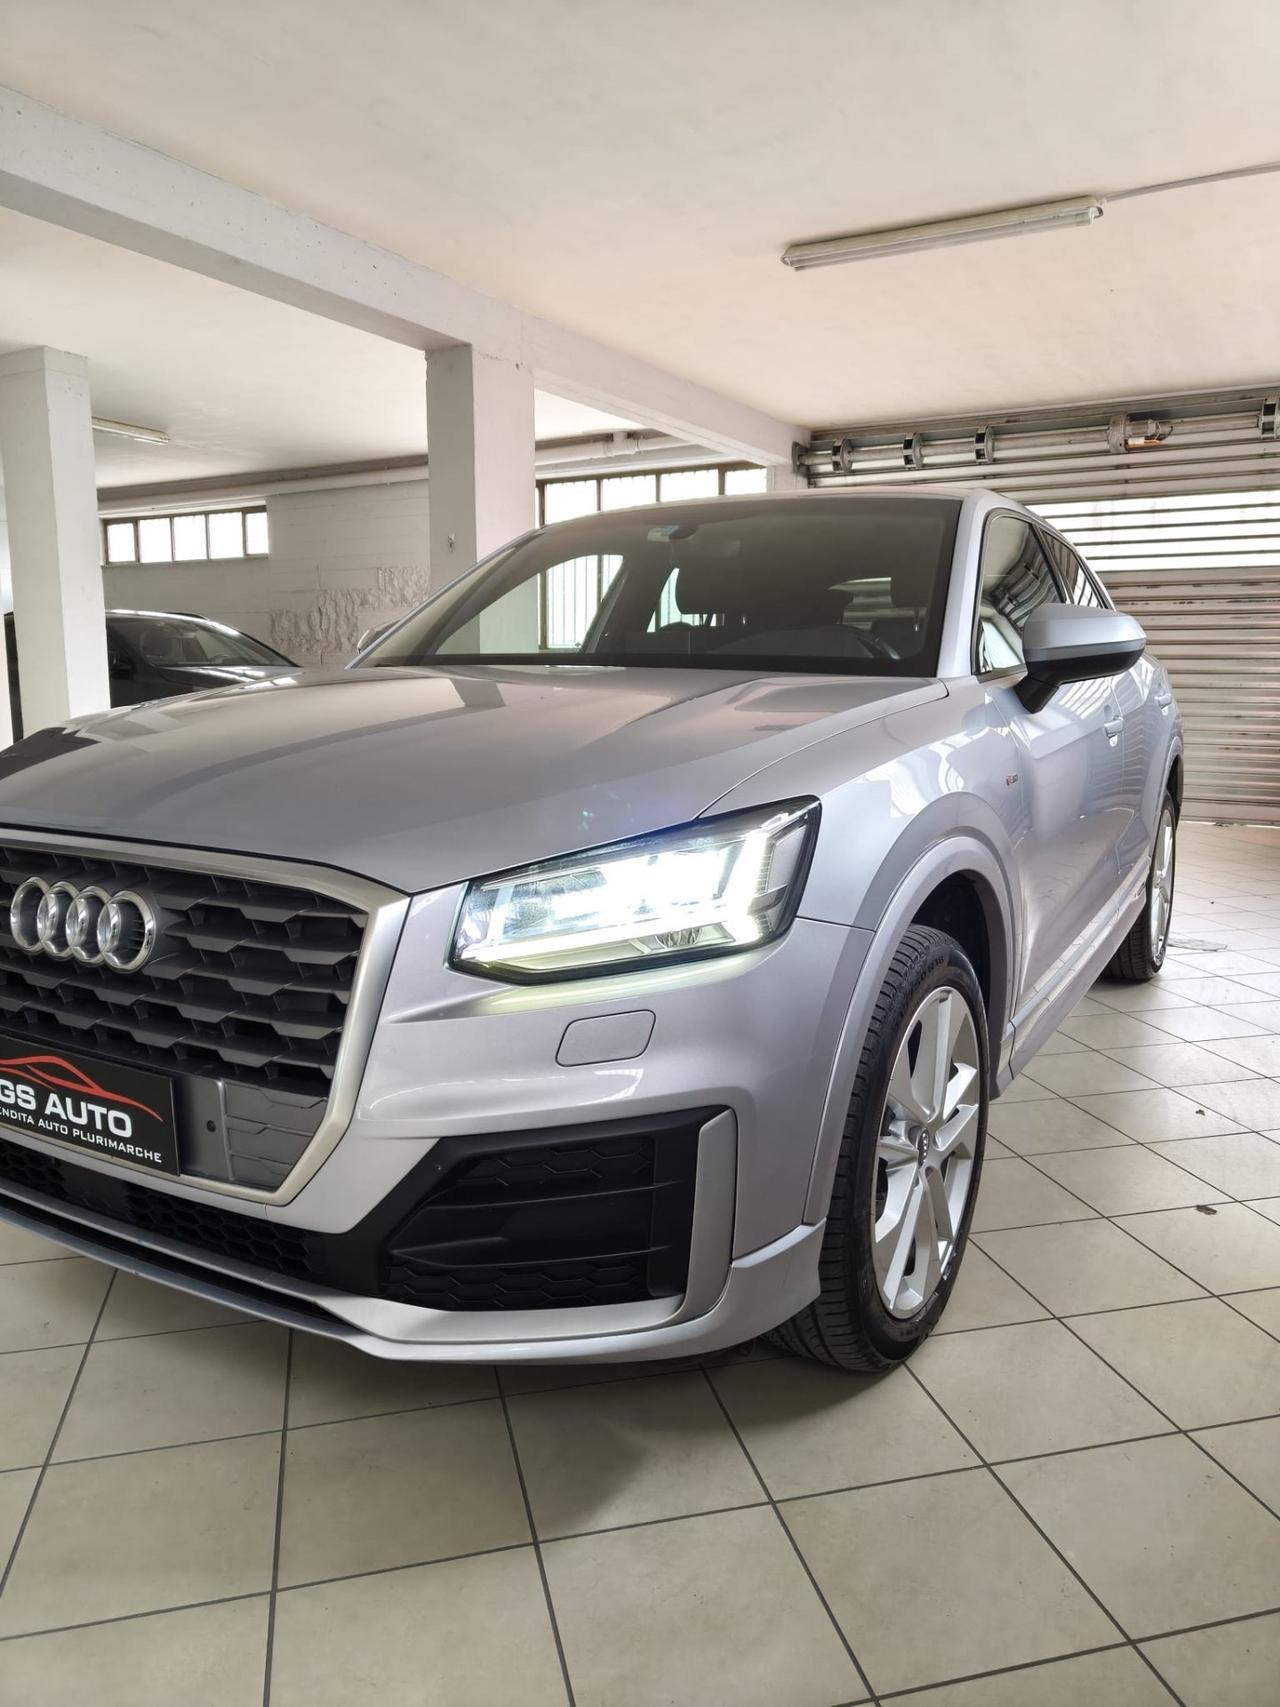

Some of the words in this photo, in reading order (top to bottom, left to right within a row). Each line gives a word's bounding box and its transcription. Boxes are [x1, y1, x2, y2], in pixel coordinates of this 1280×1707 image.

[0, 1079, 36, 1110] GS
[44, 1092, 133, 1138] AUTO
[0, 1106, 35, 1125] NDITA
[38, 1118, 69, 1135] AUTO
[72, 1128, 162, 1163] PLURIMARCHE
